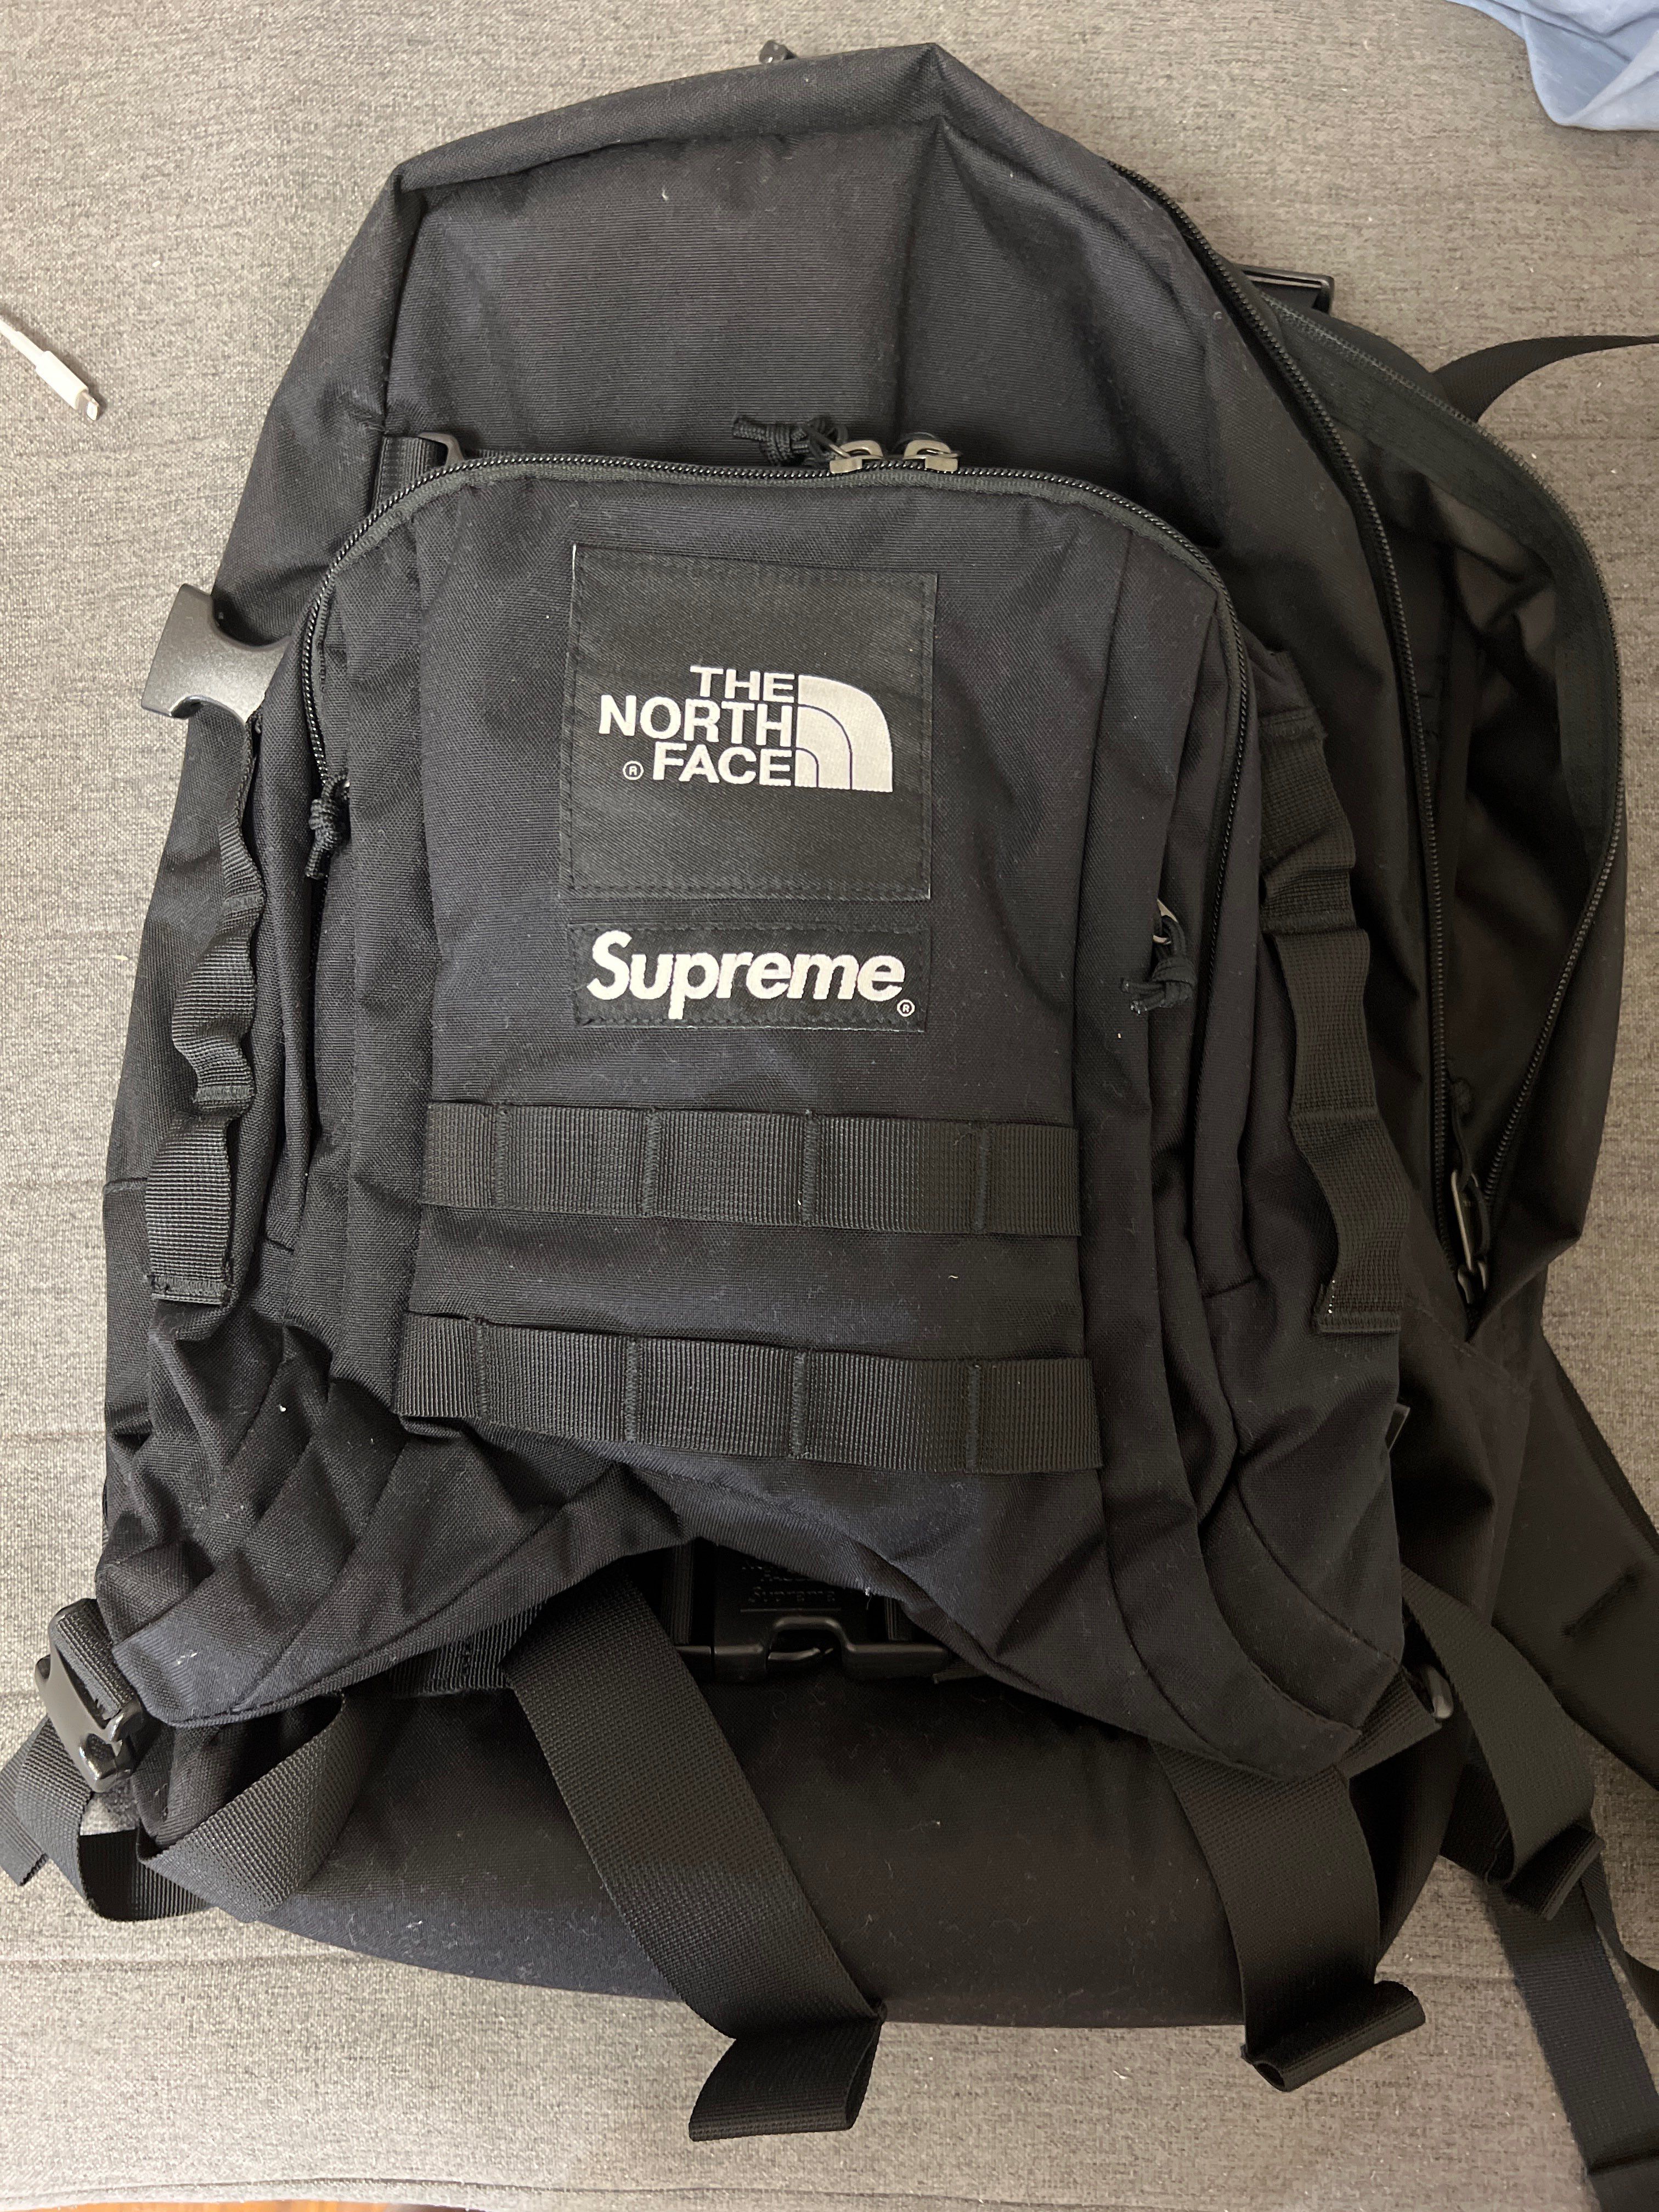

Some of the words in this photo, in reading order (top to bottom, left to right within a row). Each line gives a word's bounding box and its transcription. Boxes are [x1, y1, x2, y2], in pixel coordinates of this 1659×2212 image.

[690, 664, 795, 703] THE
[598, 694, 793, 747] NORTH
[652, 741, 793, 787] FACE
[585, 929, 906, 1020] Supreme
